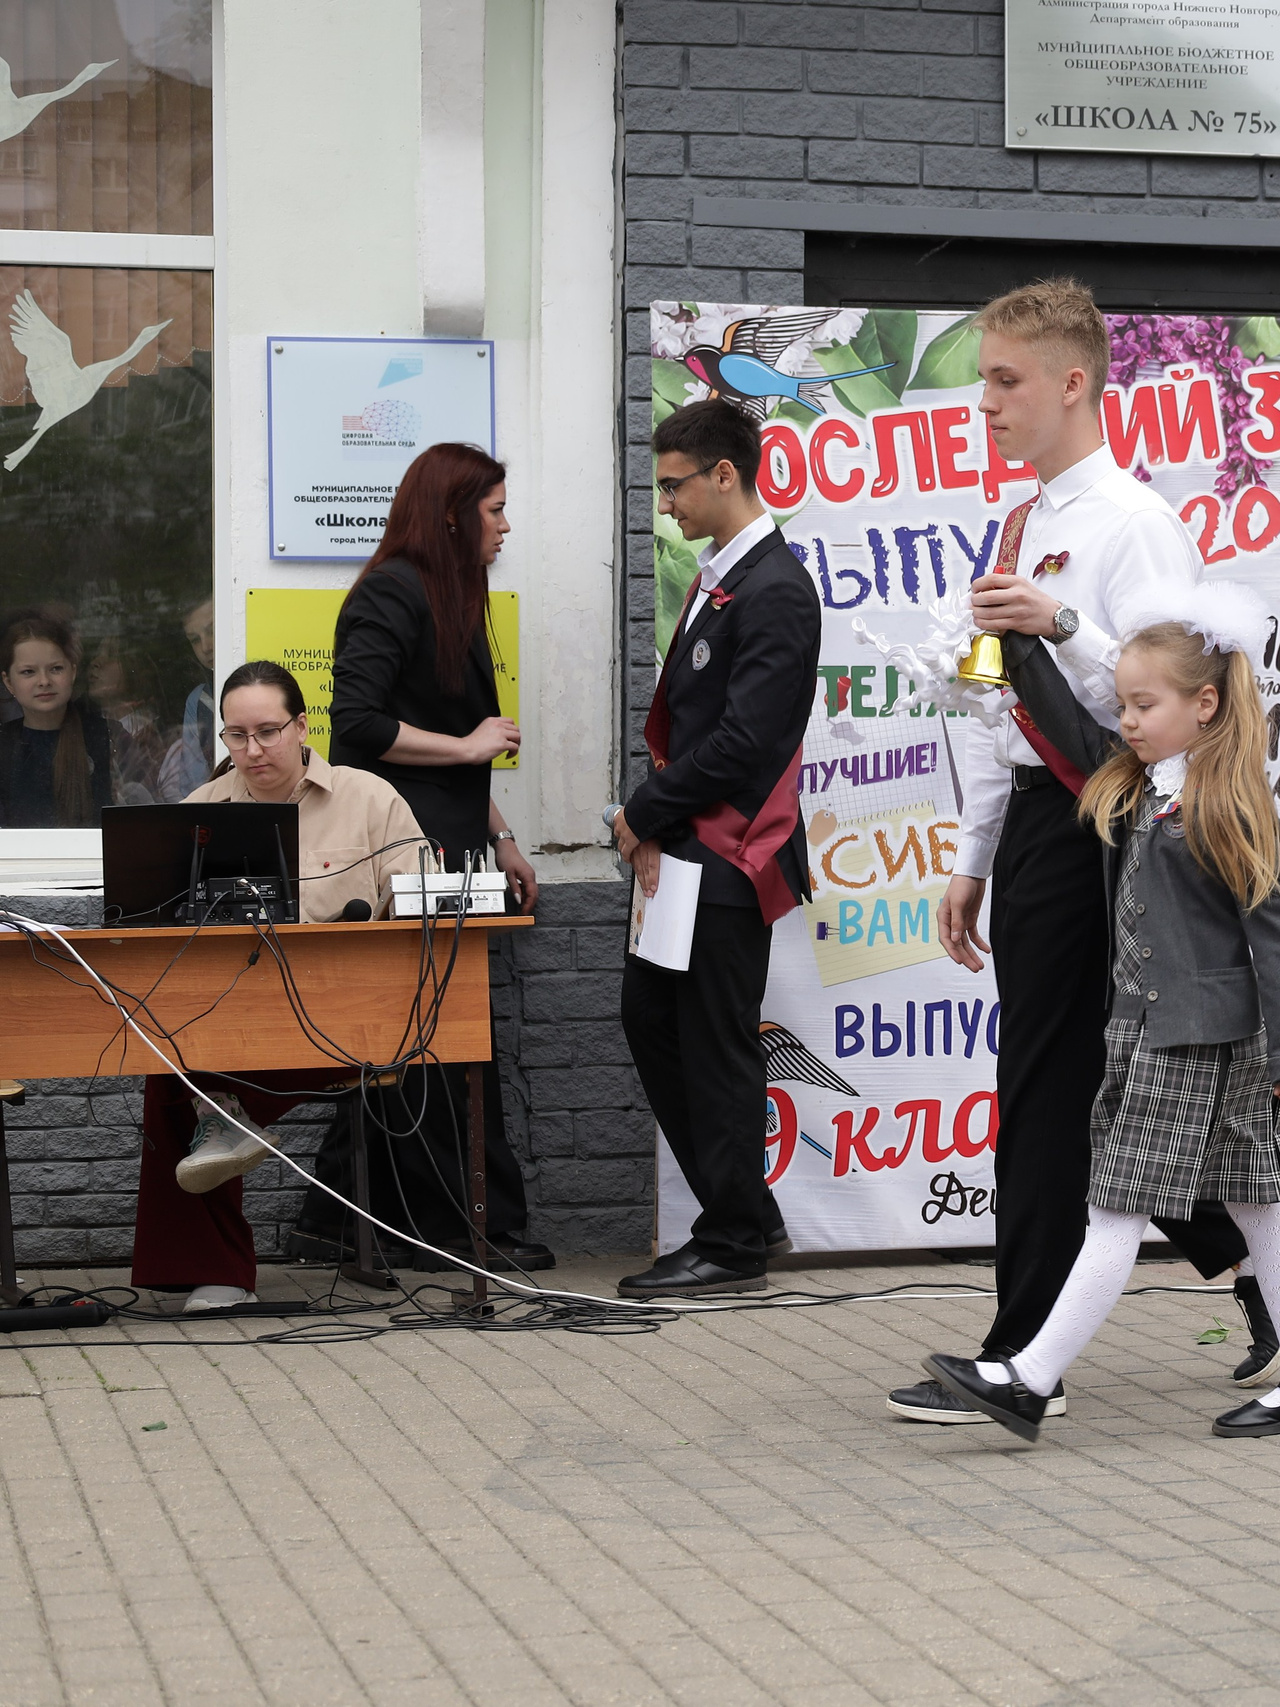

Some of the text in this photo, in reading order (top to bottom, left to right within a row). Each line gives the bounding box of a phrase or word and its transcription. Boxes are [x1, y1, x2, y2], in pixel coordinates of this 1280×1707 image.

[1132, 4, 1170, 13] города
[1173, 2, 1227, 14] Нижнего
[1090, 13, 1240, 29] Департамент образования
[1037, 41, 1275, 61] МУНИЦИПАЛЬНОЕ БЮДЖЕТНОЕ
[1064, 58, 1249, 76] ОБЩЕОБРАЗОВАТЕЛЬНОЕ
[1106, 76, 1208, 91] УЧРЕЖДЕНИЕ
[1034, 104, 1278, 135] «ШКОЛА № 75»
[398, 440, 416, 448] СРЕДА
[311, 485, 393, 494] МУНИЦИПАЛЬНОЕ
